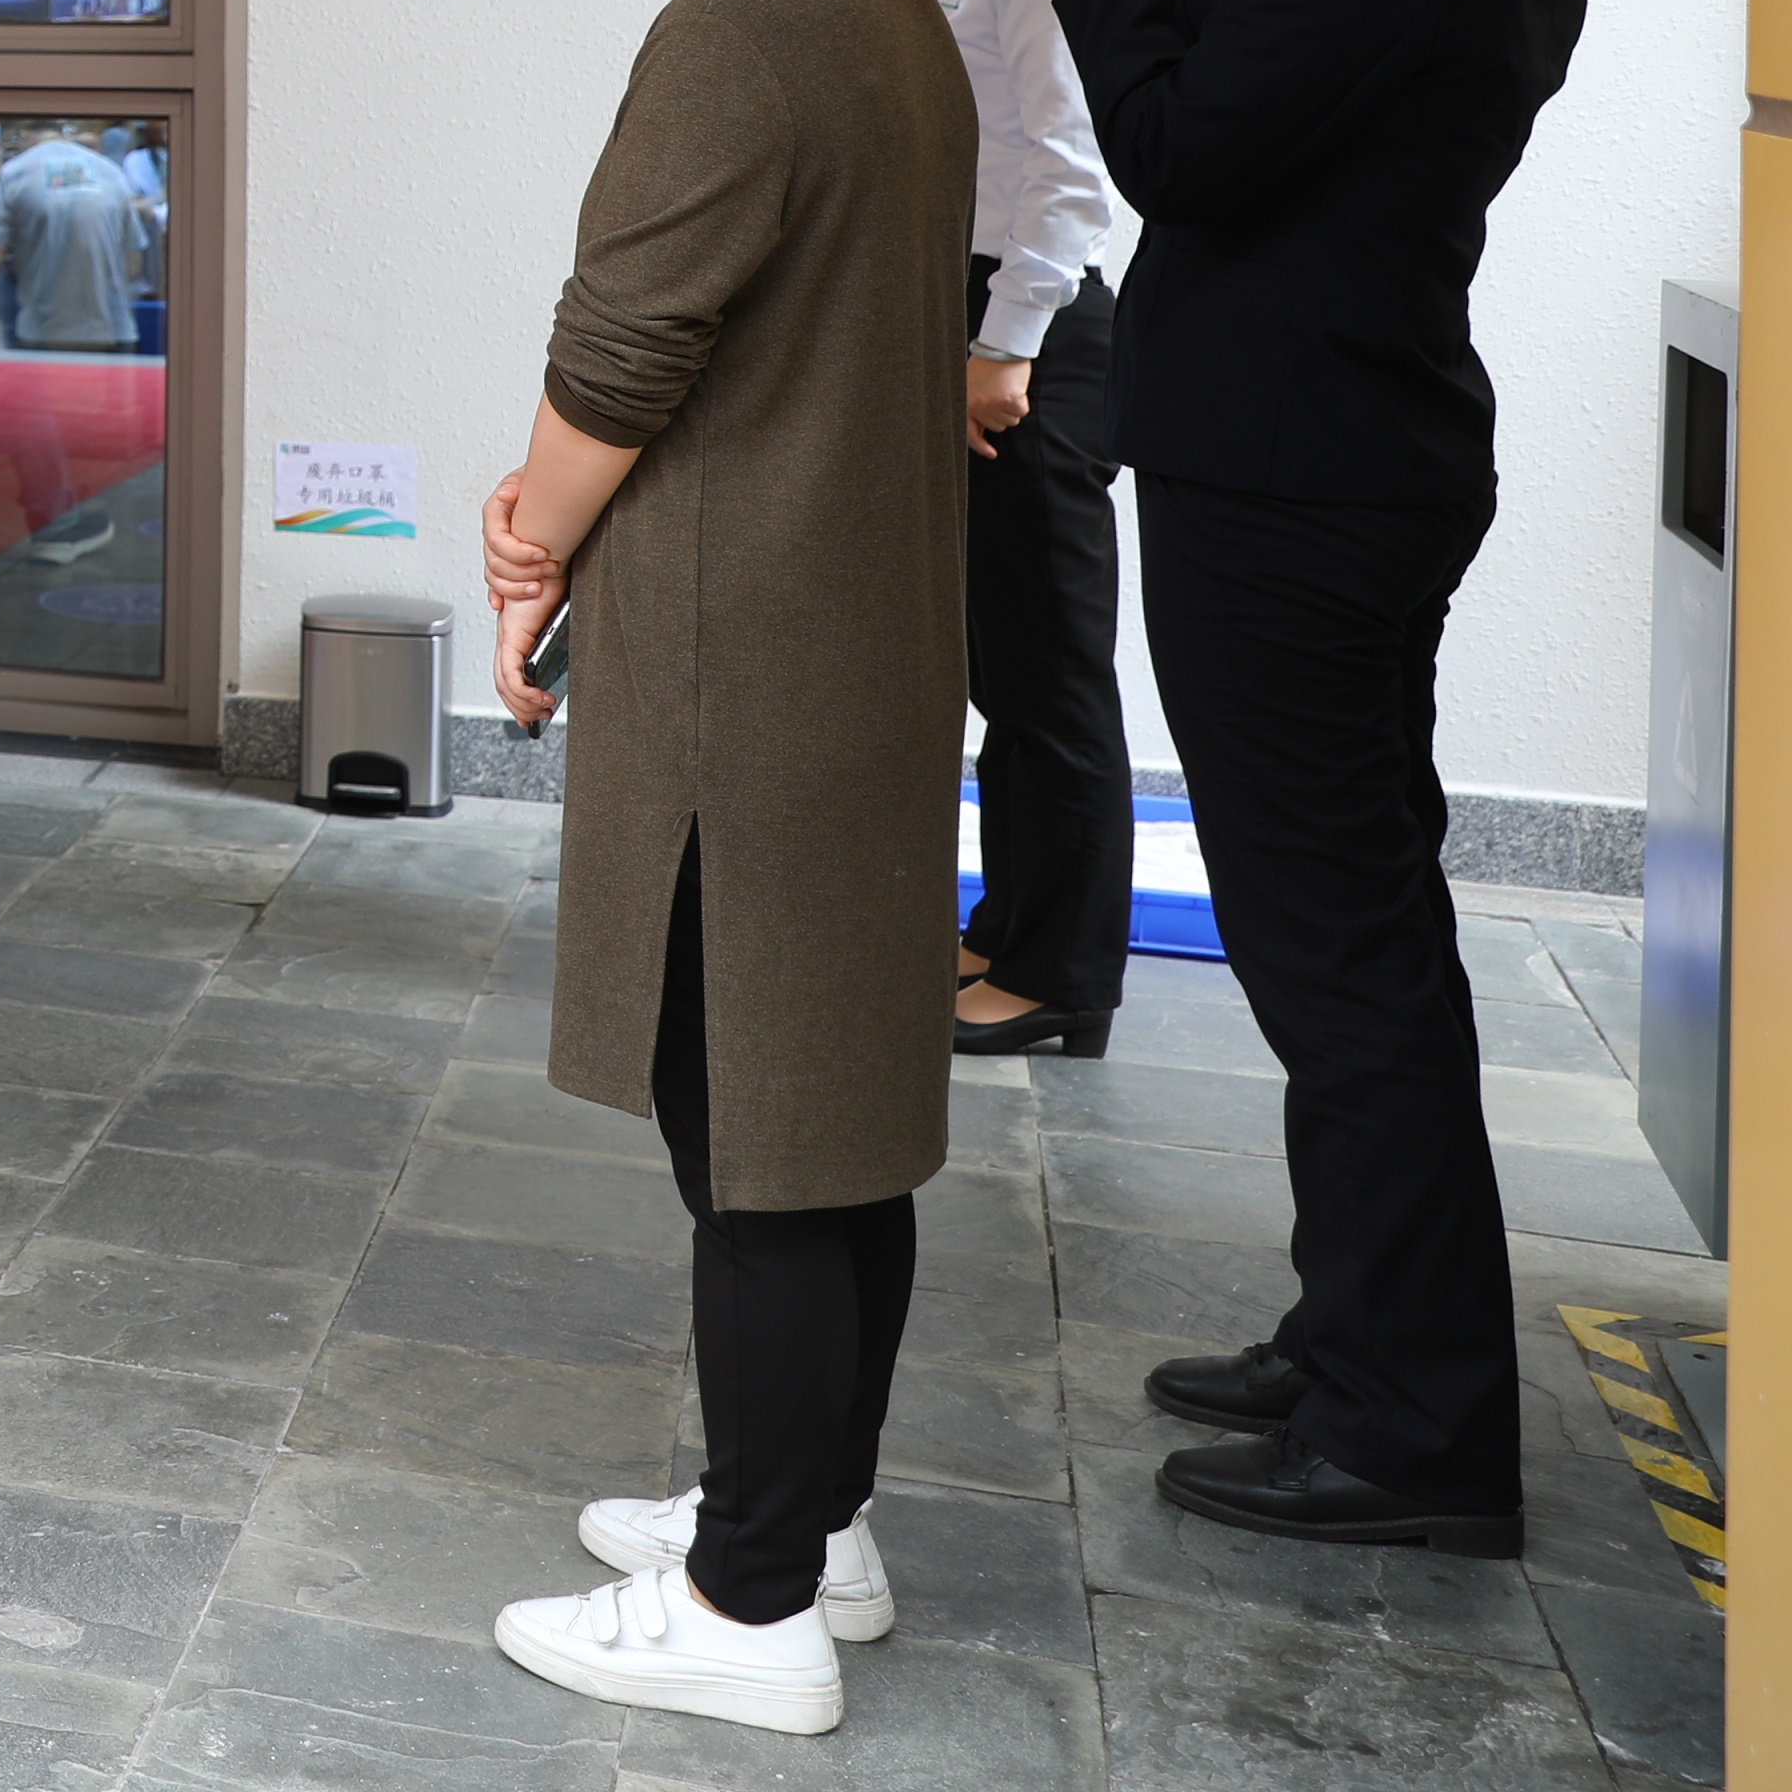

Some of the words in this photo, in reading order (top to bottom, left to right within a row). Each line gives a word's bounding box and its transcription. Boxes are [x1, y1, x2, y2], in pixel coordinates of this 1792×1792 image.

[305, 462, 385, 483] 废弃口罩
[297, 485, 396, 508] 专用垃圾桶
